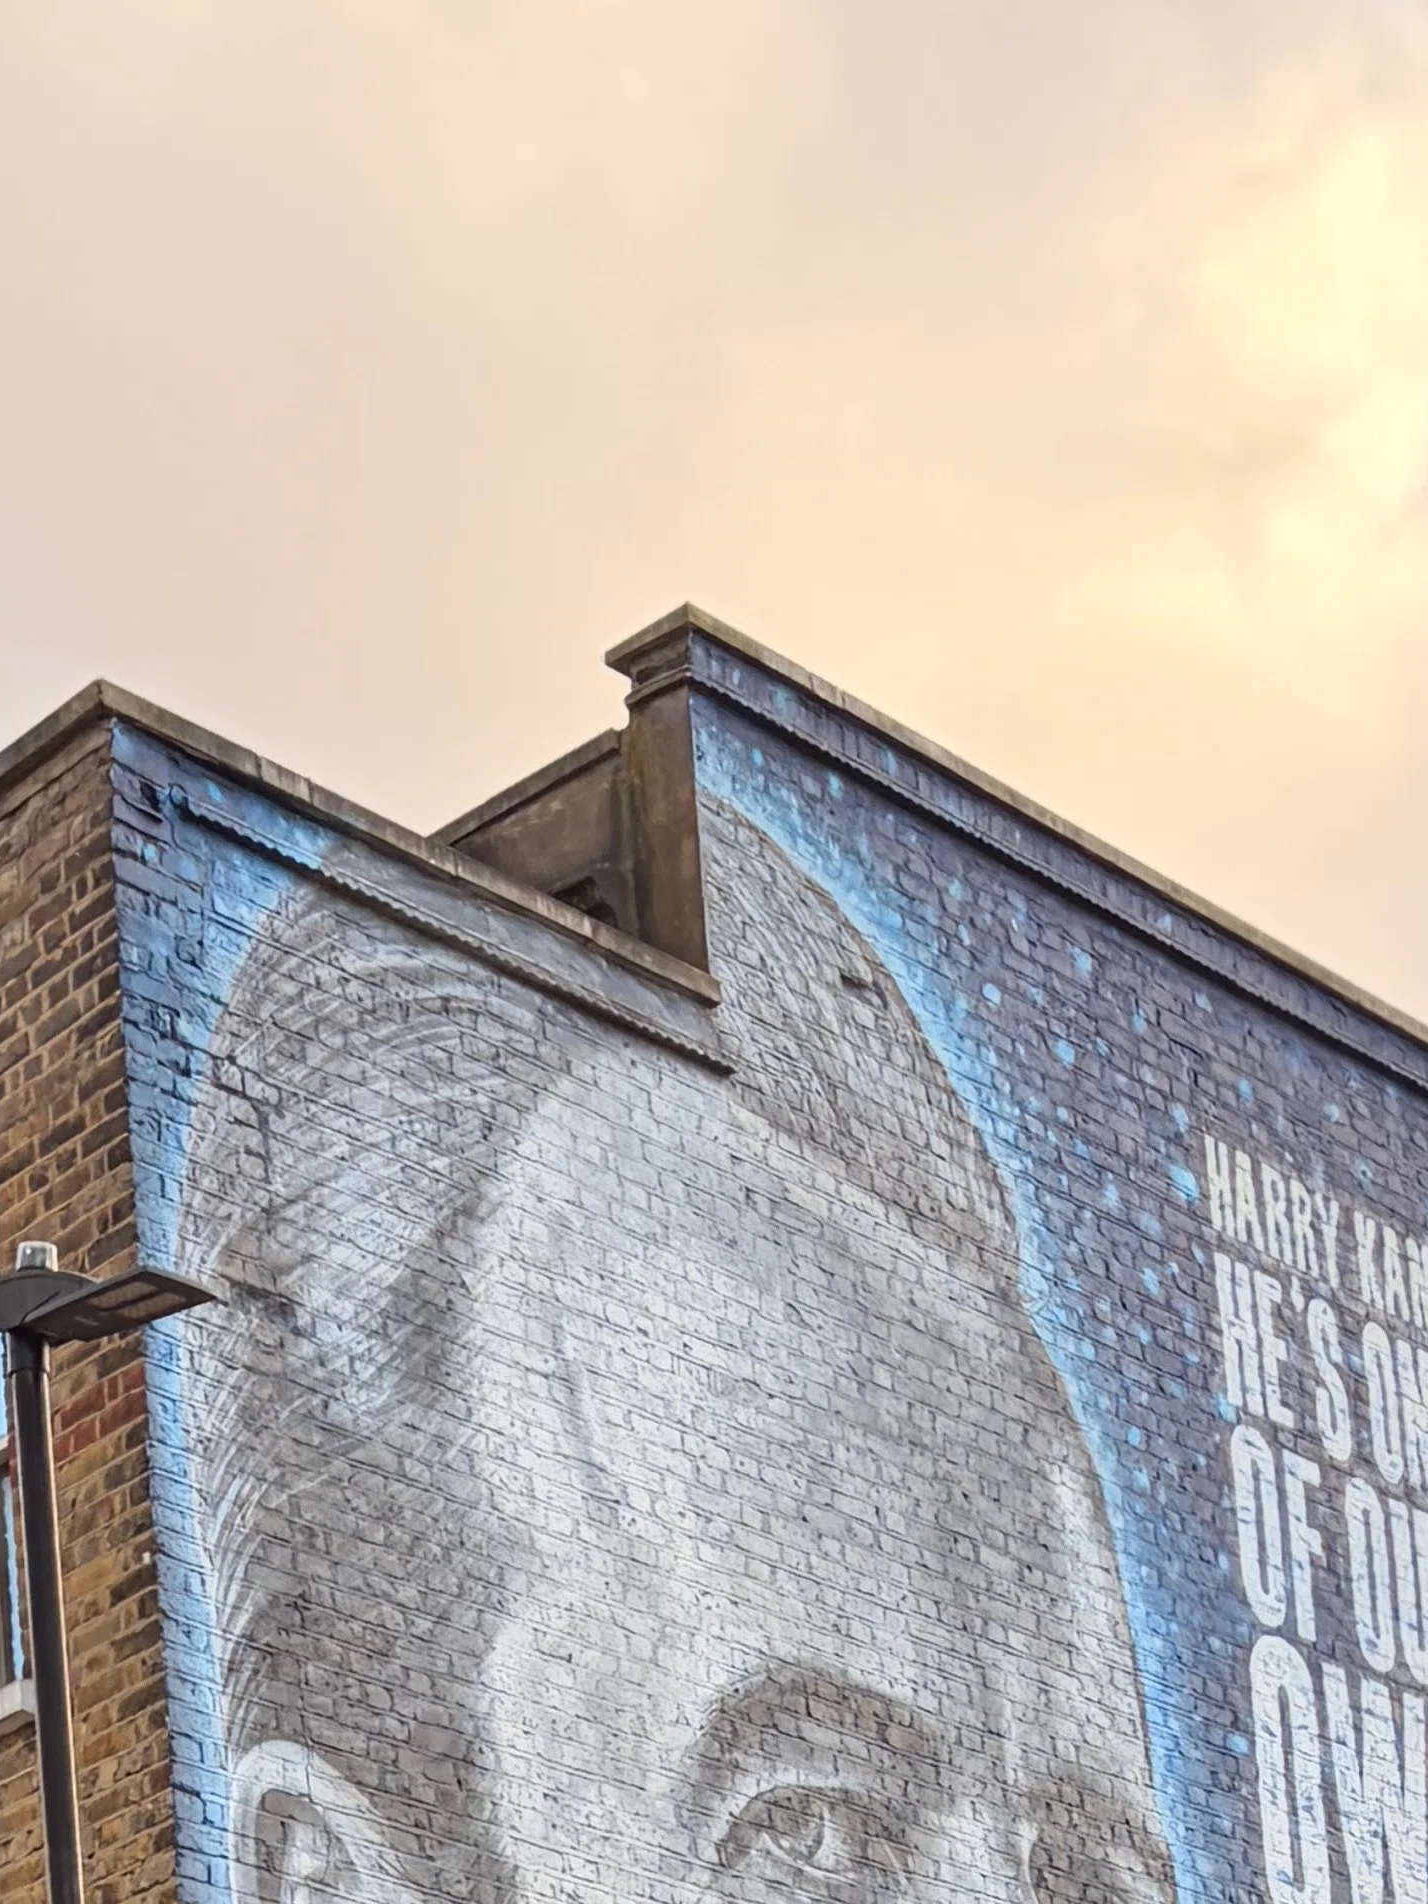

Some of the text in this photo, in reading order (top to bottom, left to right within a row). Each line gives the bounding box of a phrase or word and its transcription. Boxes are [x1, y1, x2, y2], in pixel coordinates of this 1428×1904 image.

[1205, 1134, 1339, 1289] HARRY
[1214, 1252, 1352, 1462] HE'S
[1230, 1425, 1323, 1642] OF
